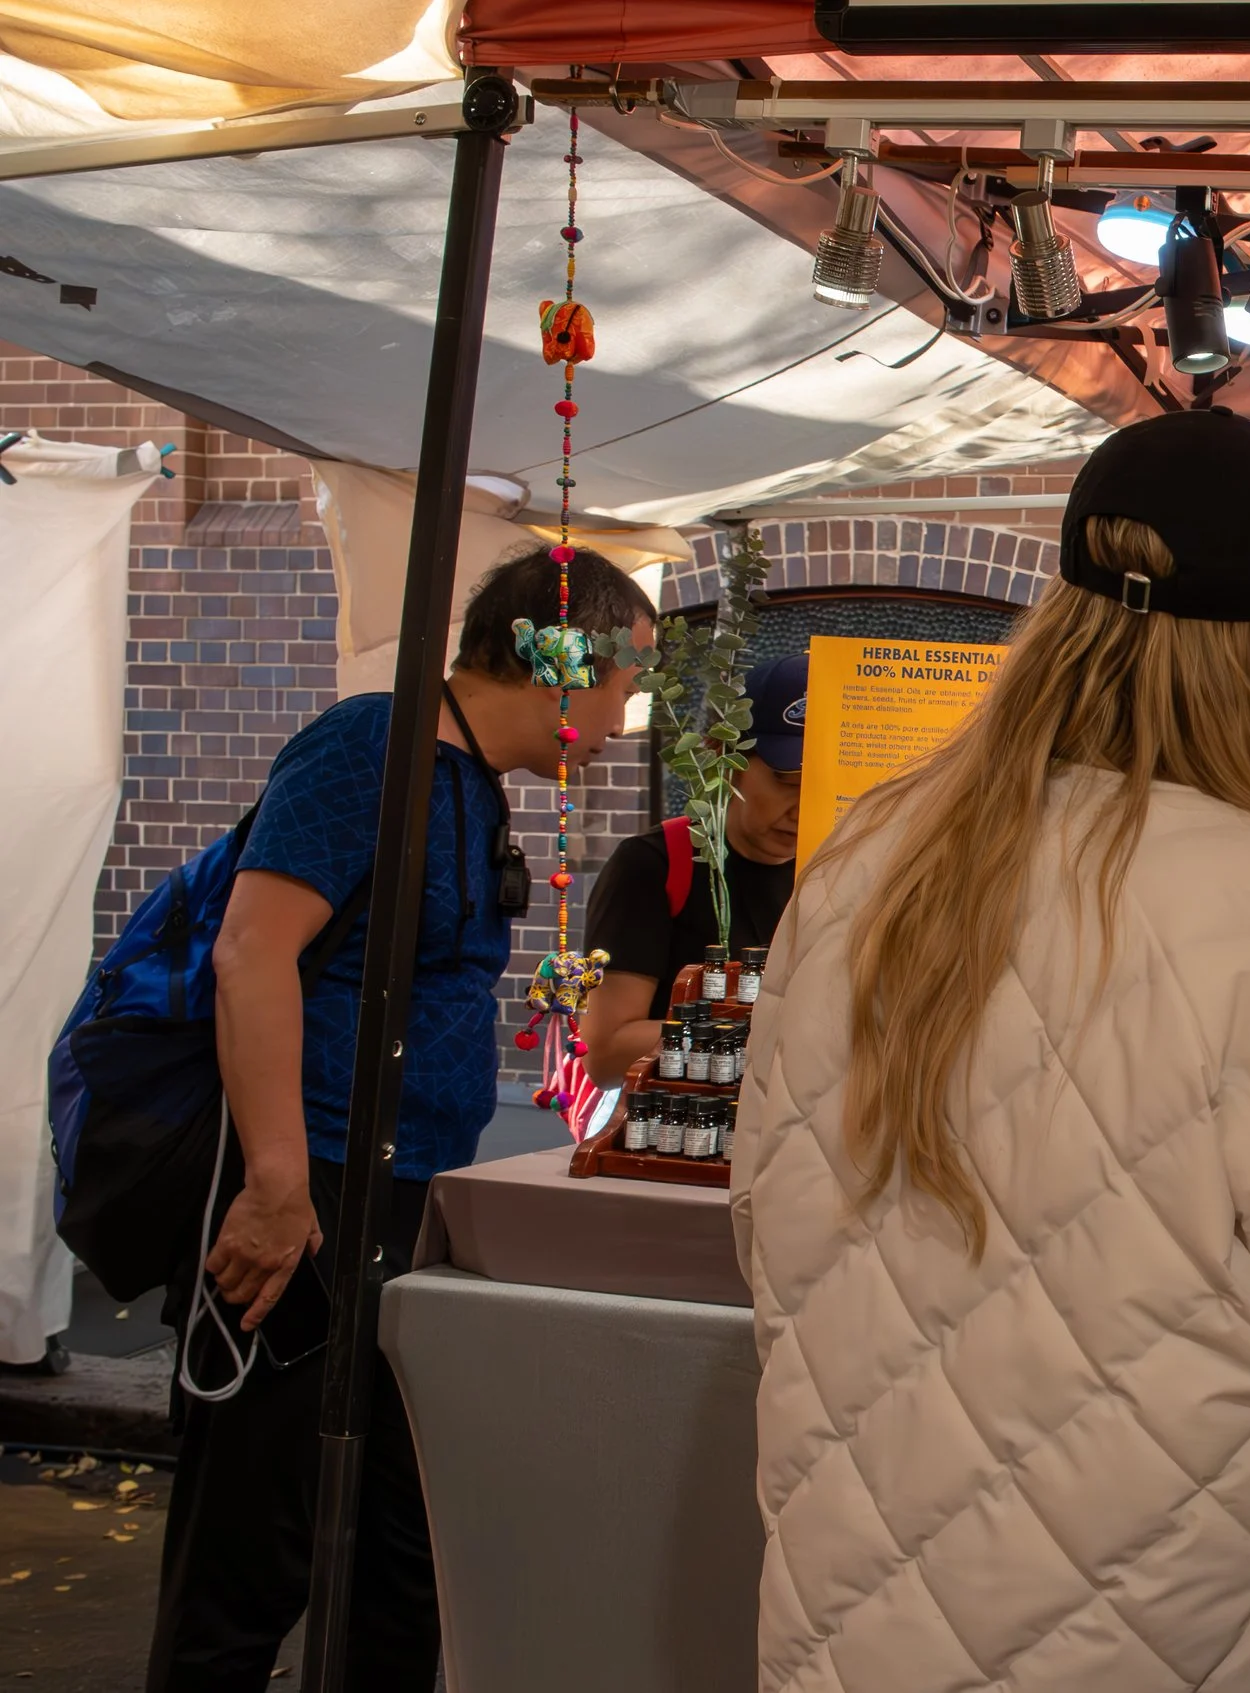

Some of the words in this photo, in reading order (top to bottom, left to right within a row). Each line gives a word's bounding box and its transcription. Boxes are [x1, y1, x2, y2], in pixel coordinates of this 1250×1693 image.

[863, 647, 920, 662] HERBAL
[856, 664, 896, 678] 100%
[902, 666, 972, 682] NATURAL
[842, 703, 850, 711] by
[856, 732, 886, 740] products
[838, 759, 862, 768] though
